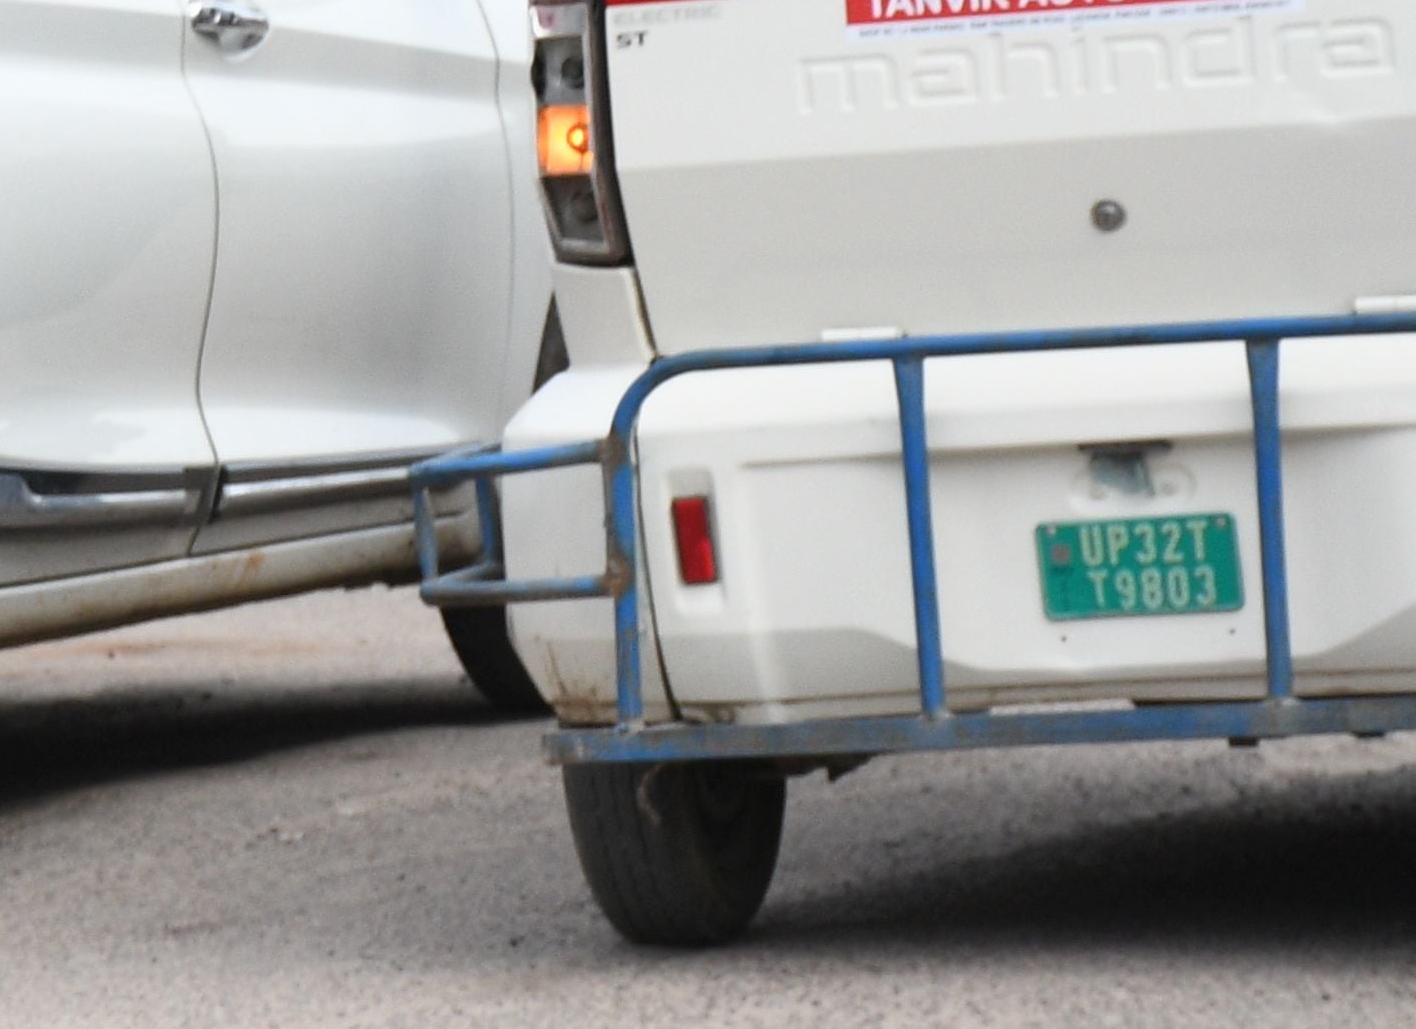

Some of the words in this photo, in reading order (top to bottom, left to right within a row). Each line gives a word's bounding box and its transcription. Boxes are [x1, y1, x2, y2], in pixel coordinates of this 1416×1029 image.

[797, 11, 1397, 116] mahindra
[1078, 519, 1208, 567] UP32T
[1087, 564, 1218, 611] T9803
